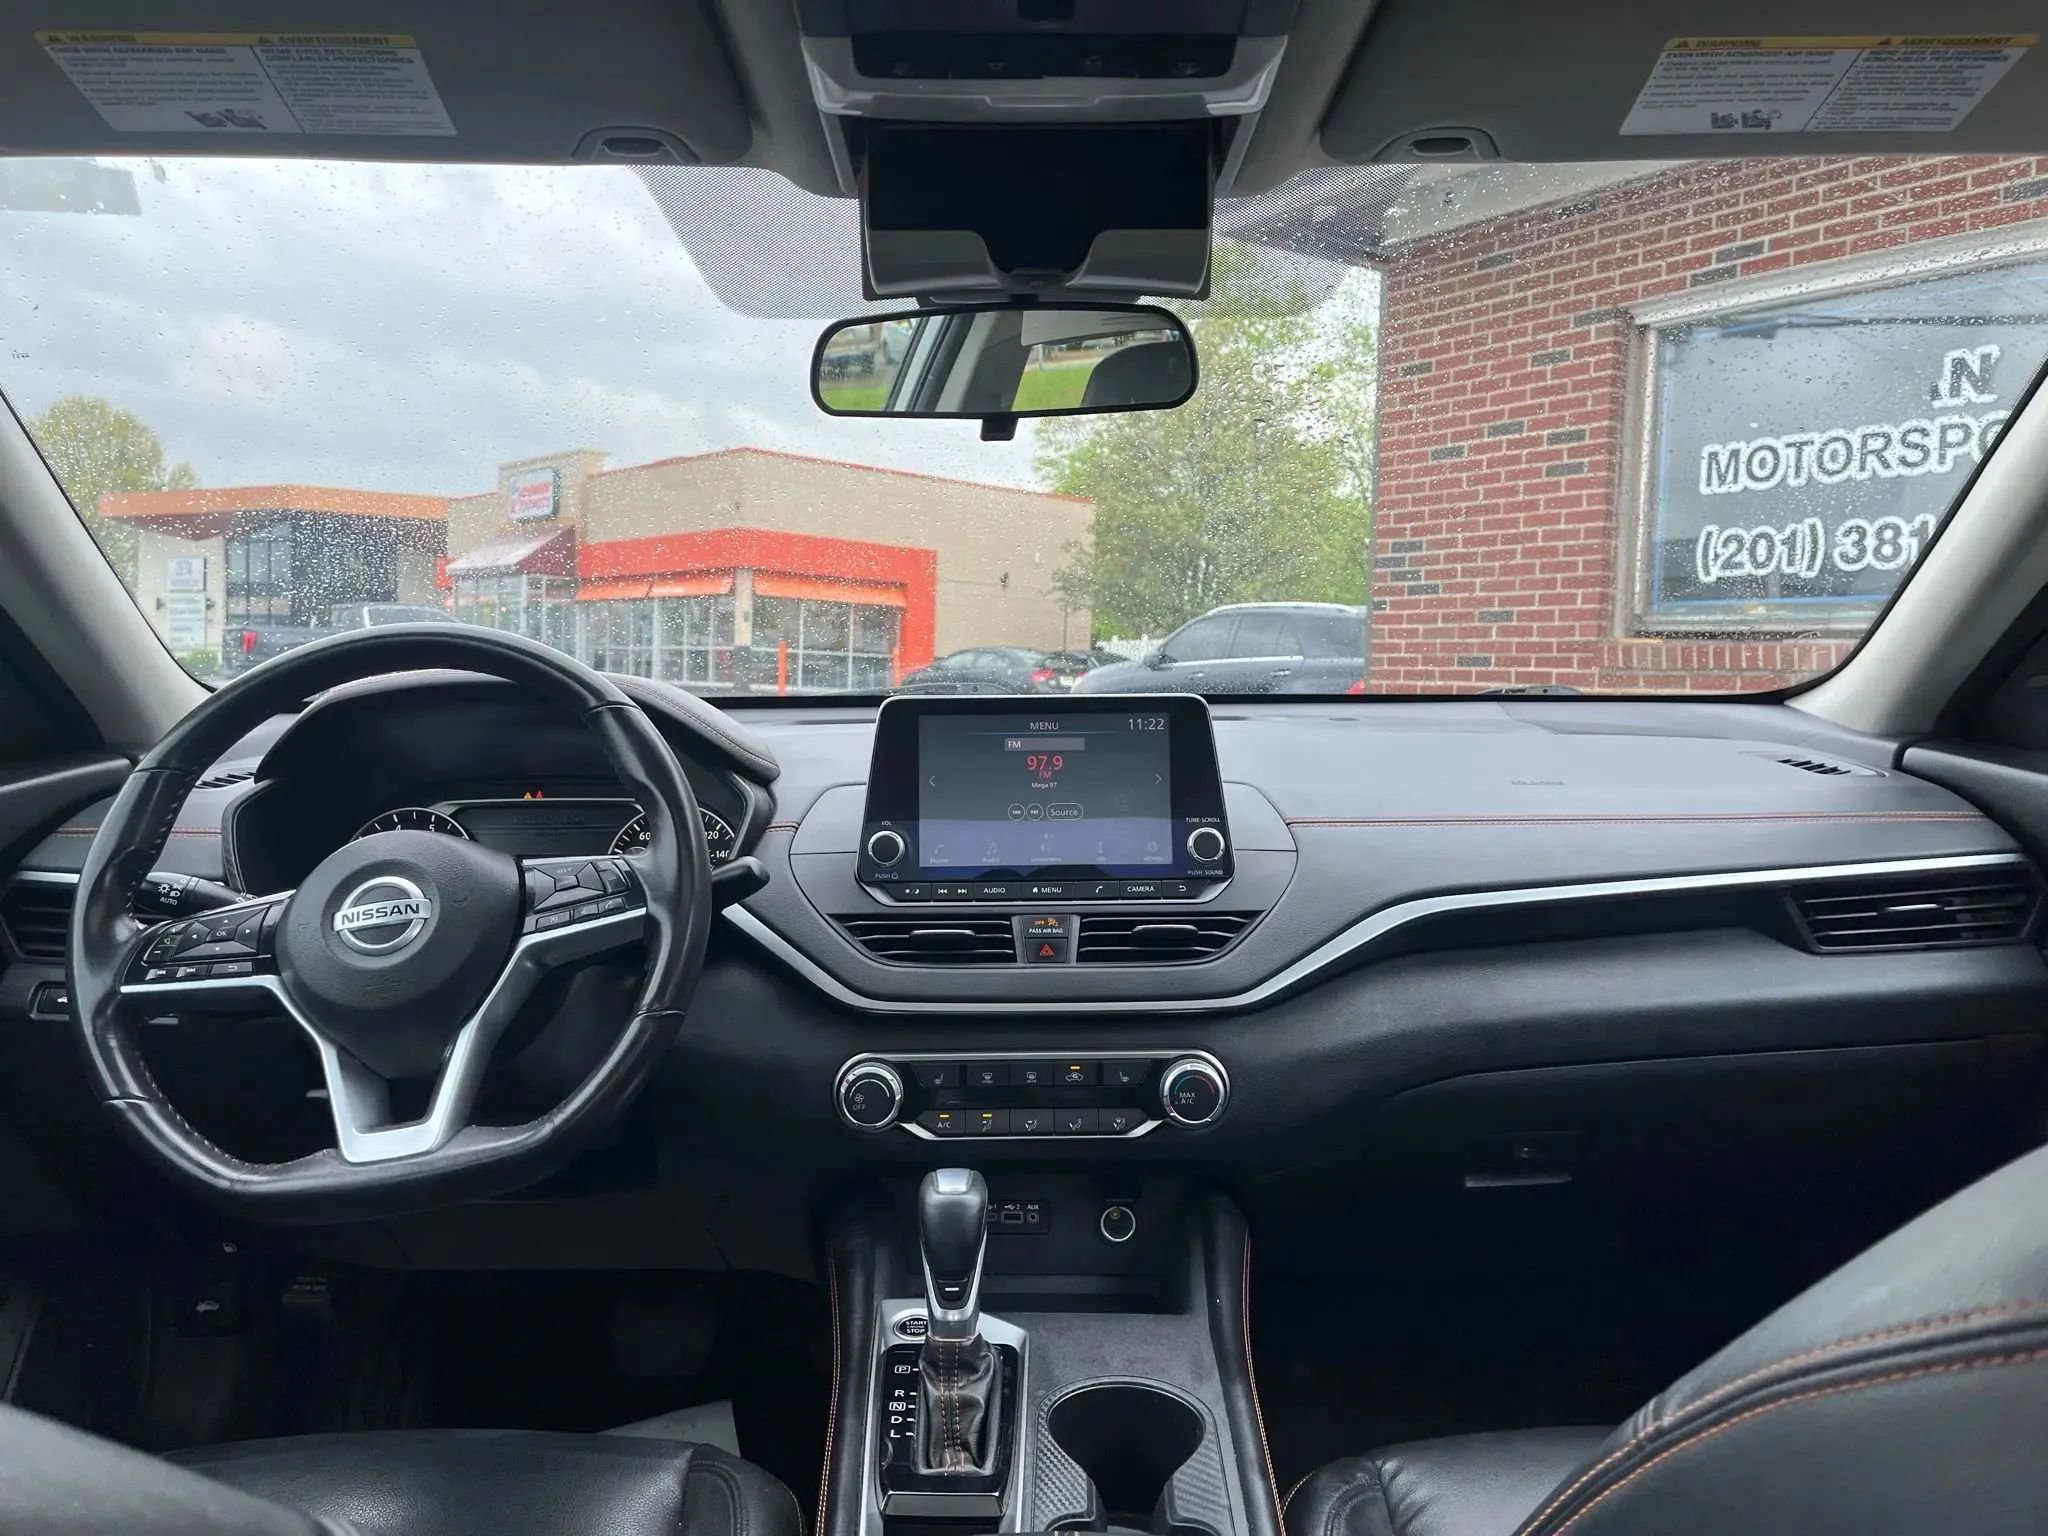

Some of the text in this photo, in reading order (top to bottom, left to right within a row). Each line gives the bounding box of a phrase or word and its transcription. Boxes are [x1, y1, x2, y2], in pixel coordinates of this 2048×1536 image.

[1697, 517, 1825, 582] (201)
[1030, 721, 1059, 730] MENU
[1128, 718, 1165, 731] 11:22
[1007, 741, 1022, 749] FM
[1026, 755, 1064, 771] 97.9
[1039, 771, 1052, 779] FM
[1031, 782, 1049, 790] Mega
[1050, 807, 1079, 817] Source
[639, 831, 651, 841] 60
[160, 896, 178, 905] AUTO
[341, 903, 420, 926] NISSAN
[894, 1389, 905, 1397] R
[891, 1416, 902, 1424] D
[890, 1429, 901, 1438] L
